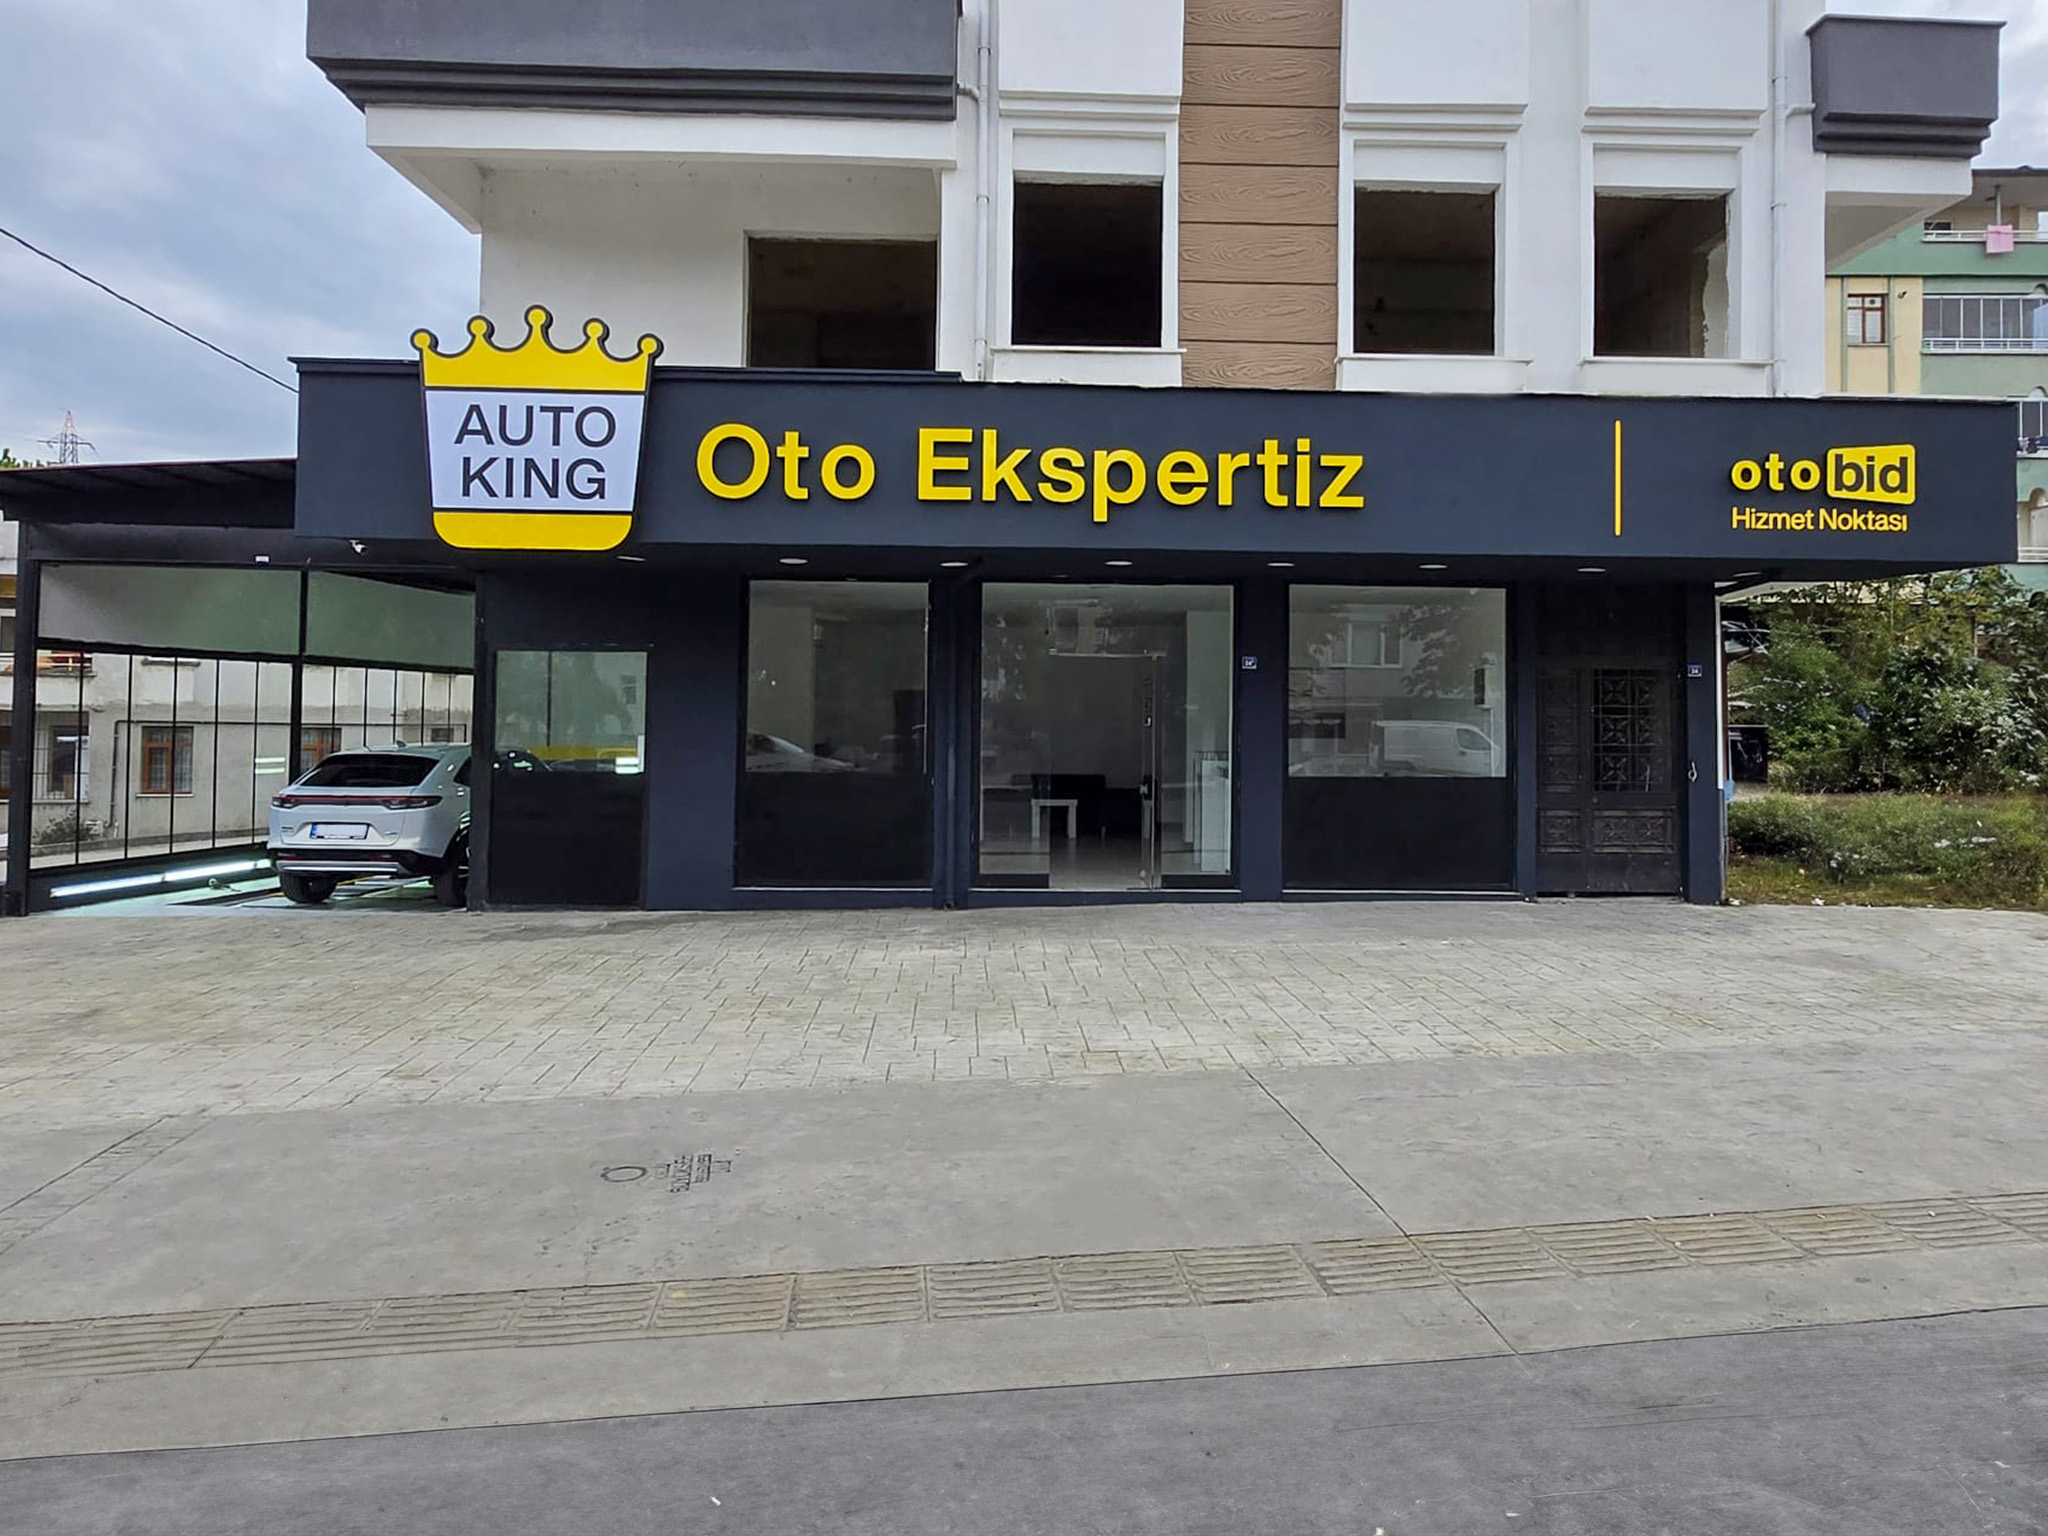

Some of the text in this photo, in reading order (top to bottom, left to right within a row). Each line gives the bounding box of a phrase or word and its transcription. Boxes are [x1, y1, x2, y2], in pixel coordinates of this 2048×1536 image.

[453, 404, 617, 448] AUTO
[461, 456, 606, 500] KING
[696, 423, 1365, 522] Oto Ekspertiz
[1731, 507, 1908, 532] Hizmet Noktası
